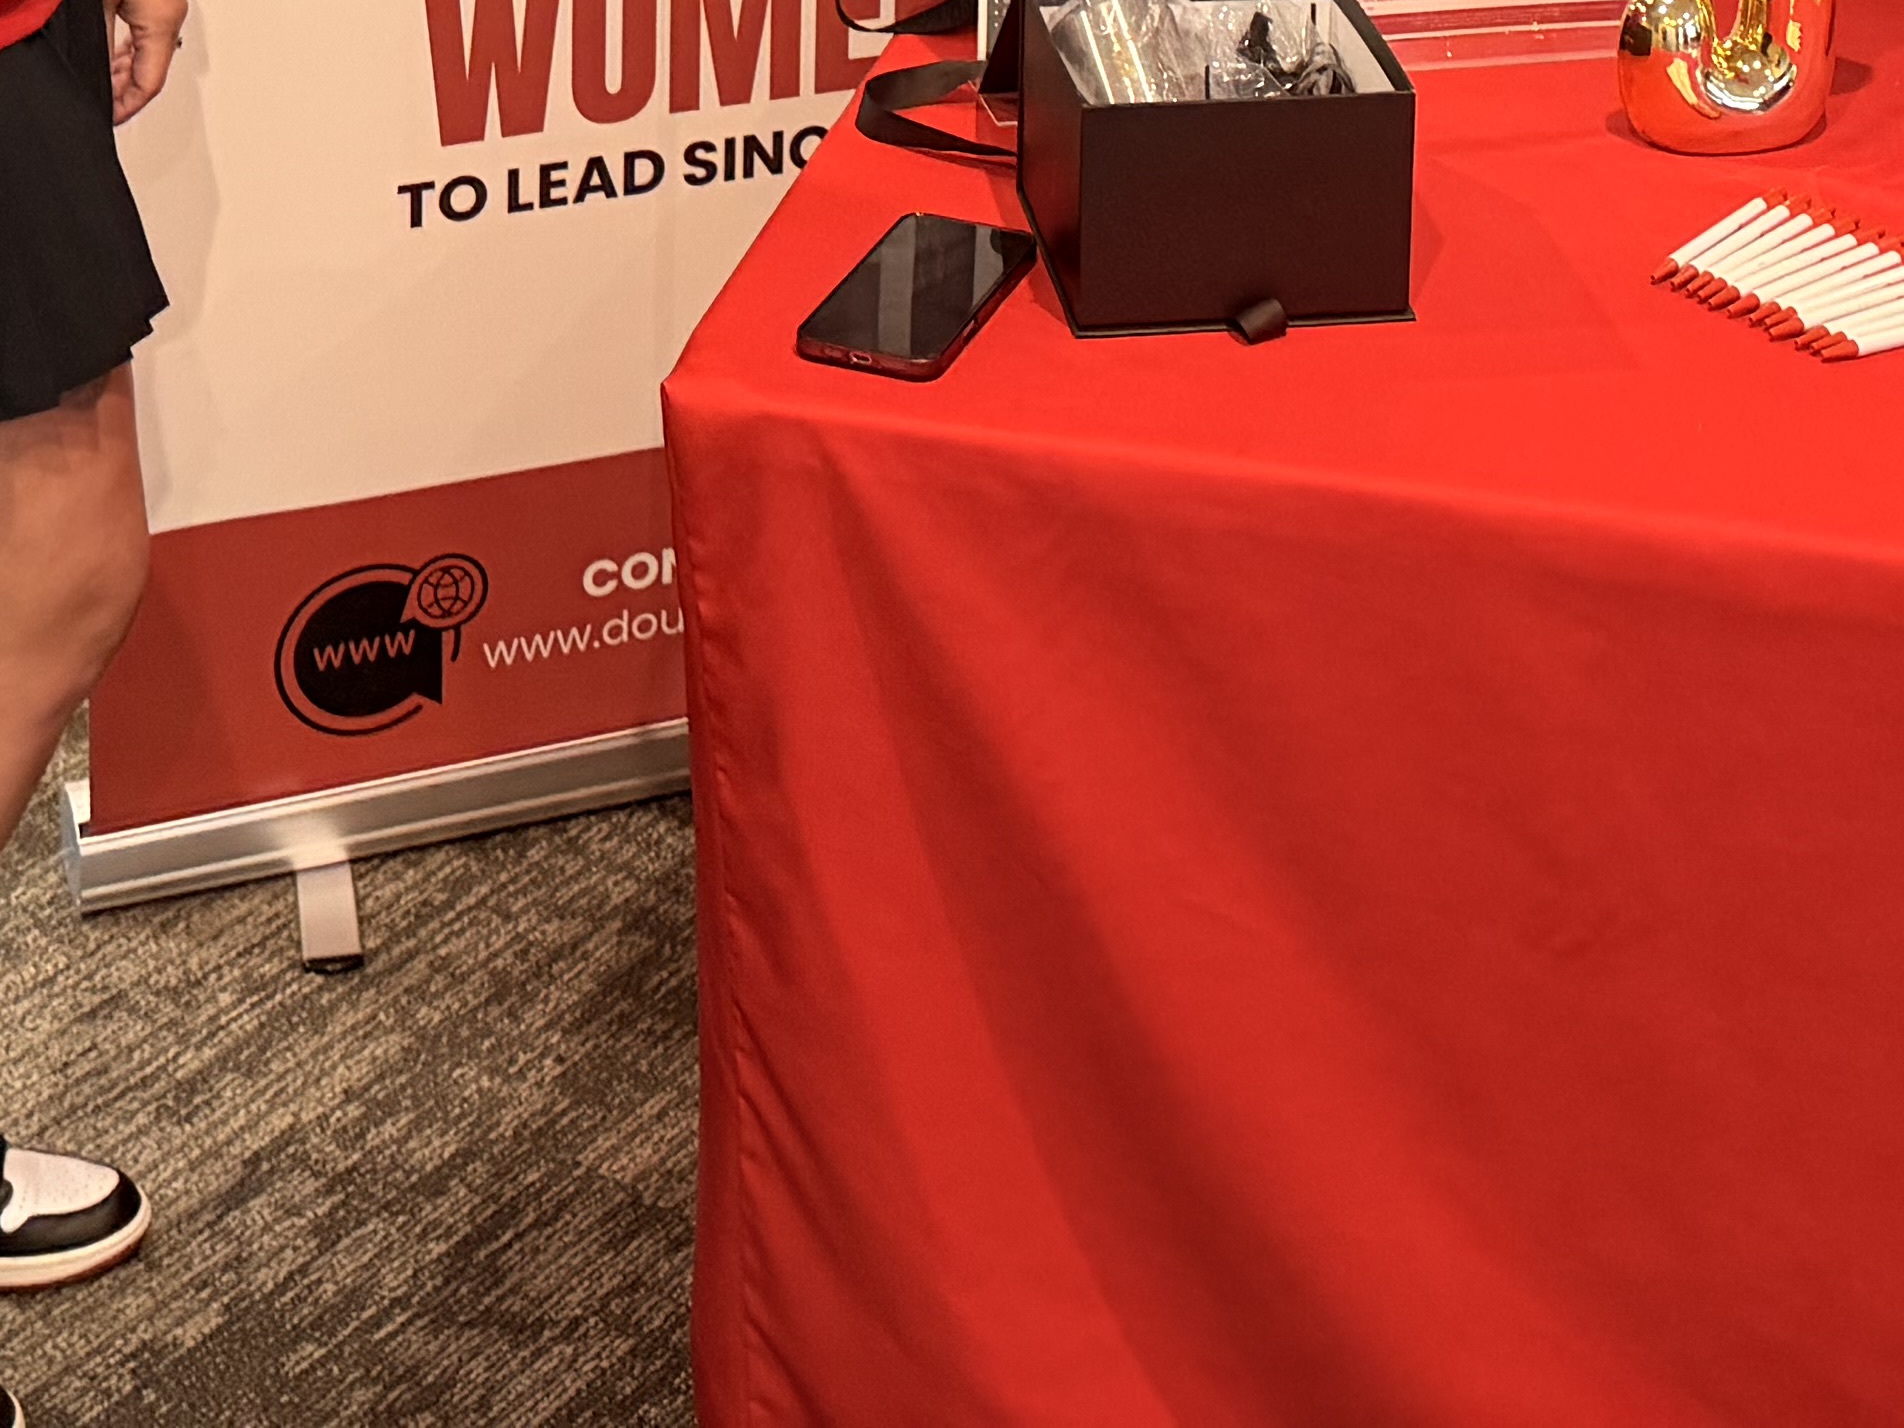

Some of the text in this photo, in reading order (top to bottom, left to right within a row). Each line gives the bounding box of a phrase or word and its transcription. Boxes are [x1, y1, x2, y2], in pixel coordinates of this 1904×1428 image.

[397, 174, 488, 229] TO
[506, 148, 666, 215] LEAD
[312, 628, 417, 673] www
[482, 606, 685, 670] www.dou
